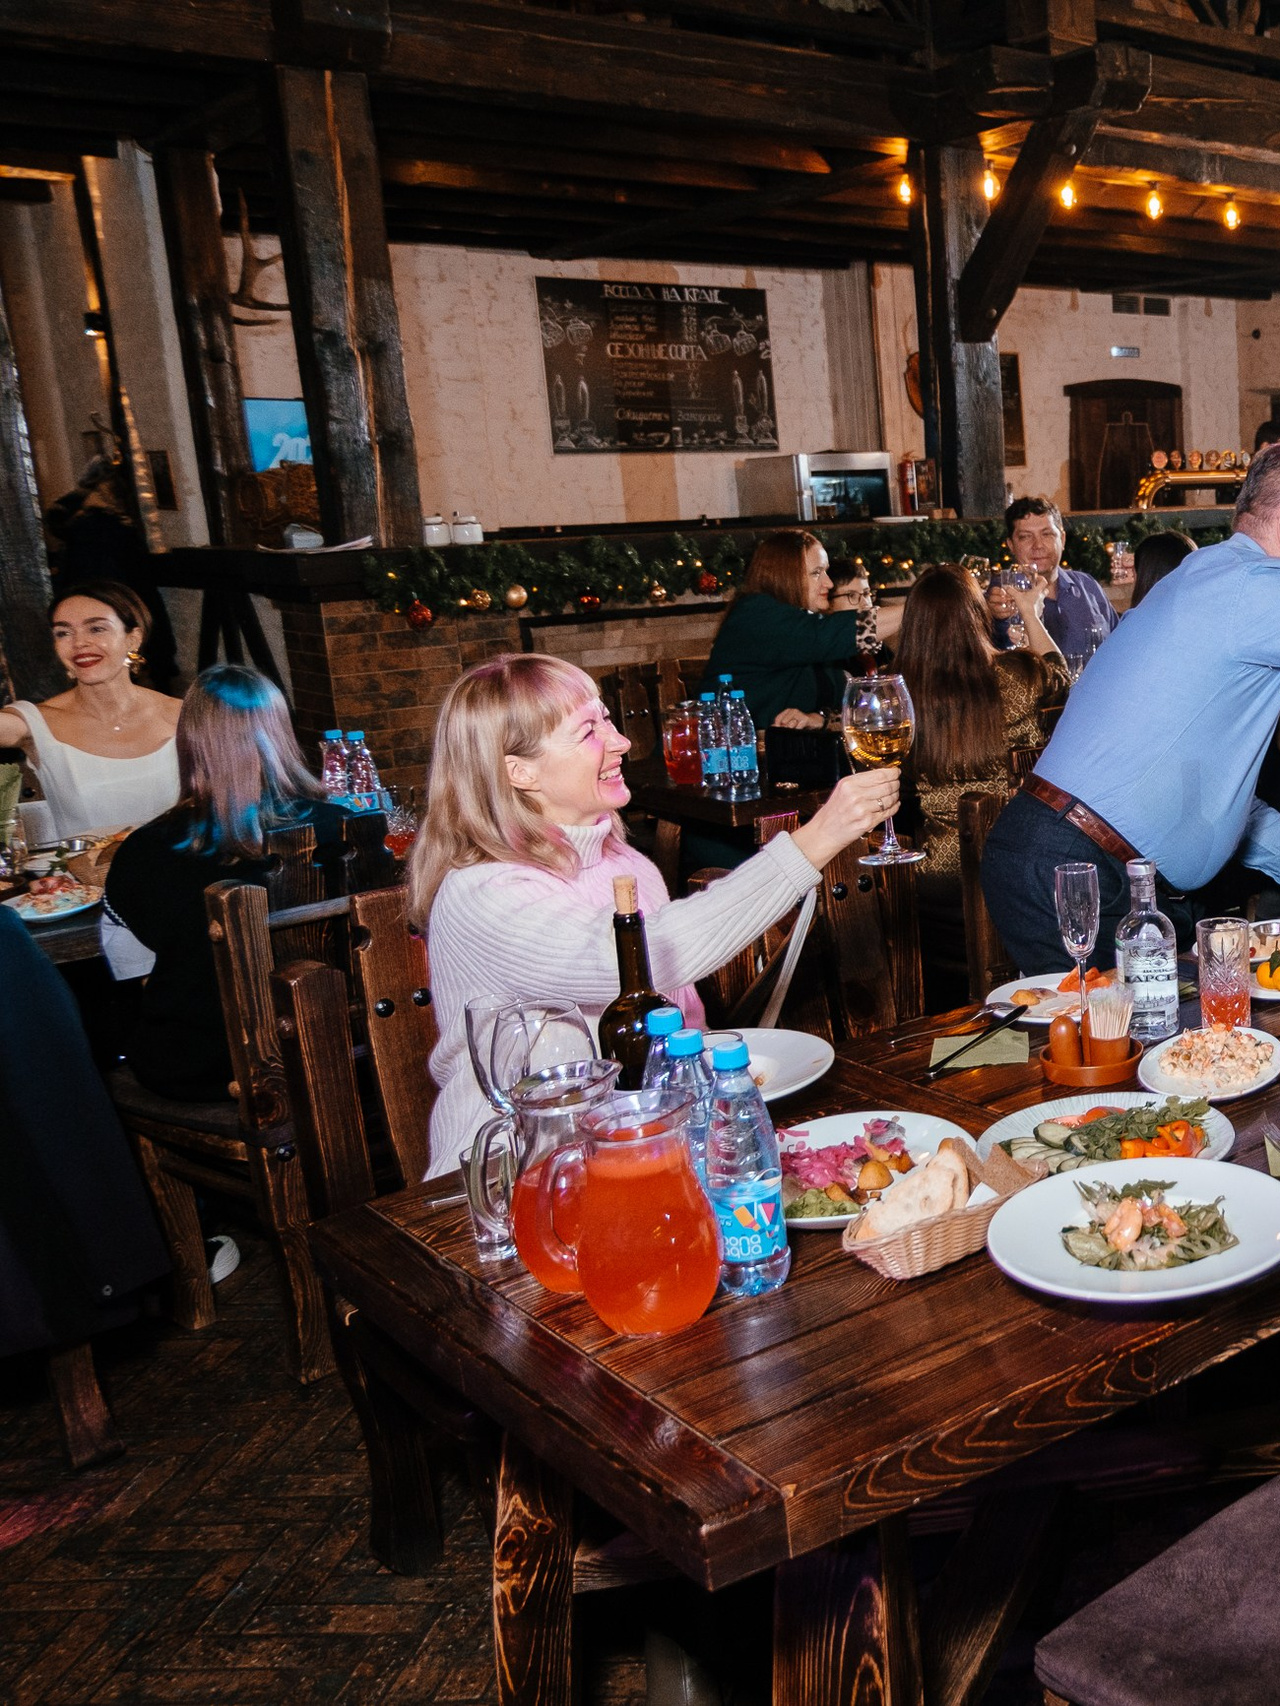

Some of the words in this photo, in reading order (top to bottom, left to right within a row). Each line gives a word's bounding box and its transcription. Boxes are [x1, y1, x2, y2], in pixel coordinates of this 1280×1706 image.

[661, 286, 682, 302] НА
[606, 342, 668, 360] СЕЗОННЫЕ
[669, 343, 709, 362] СОРТА
